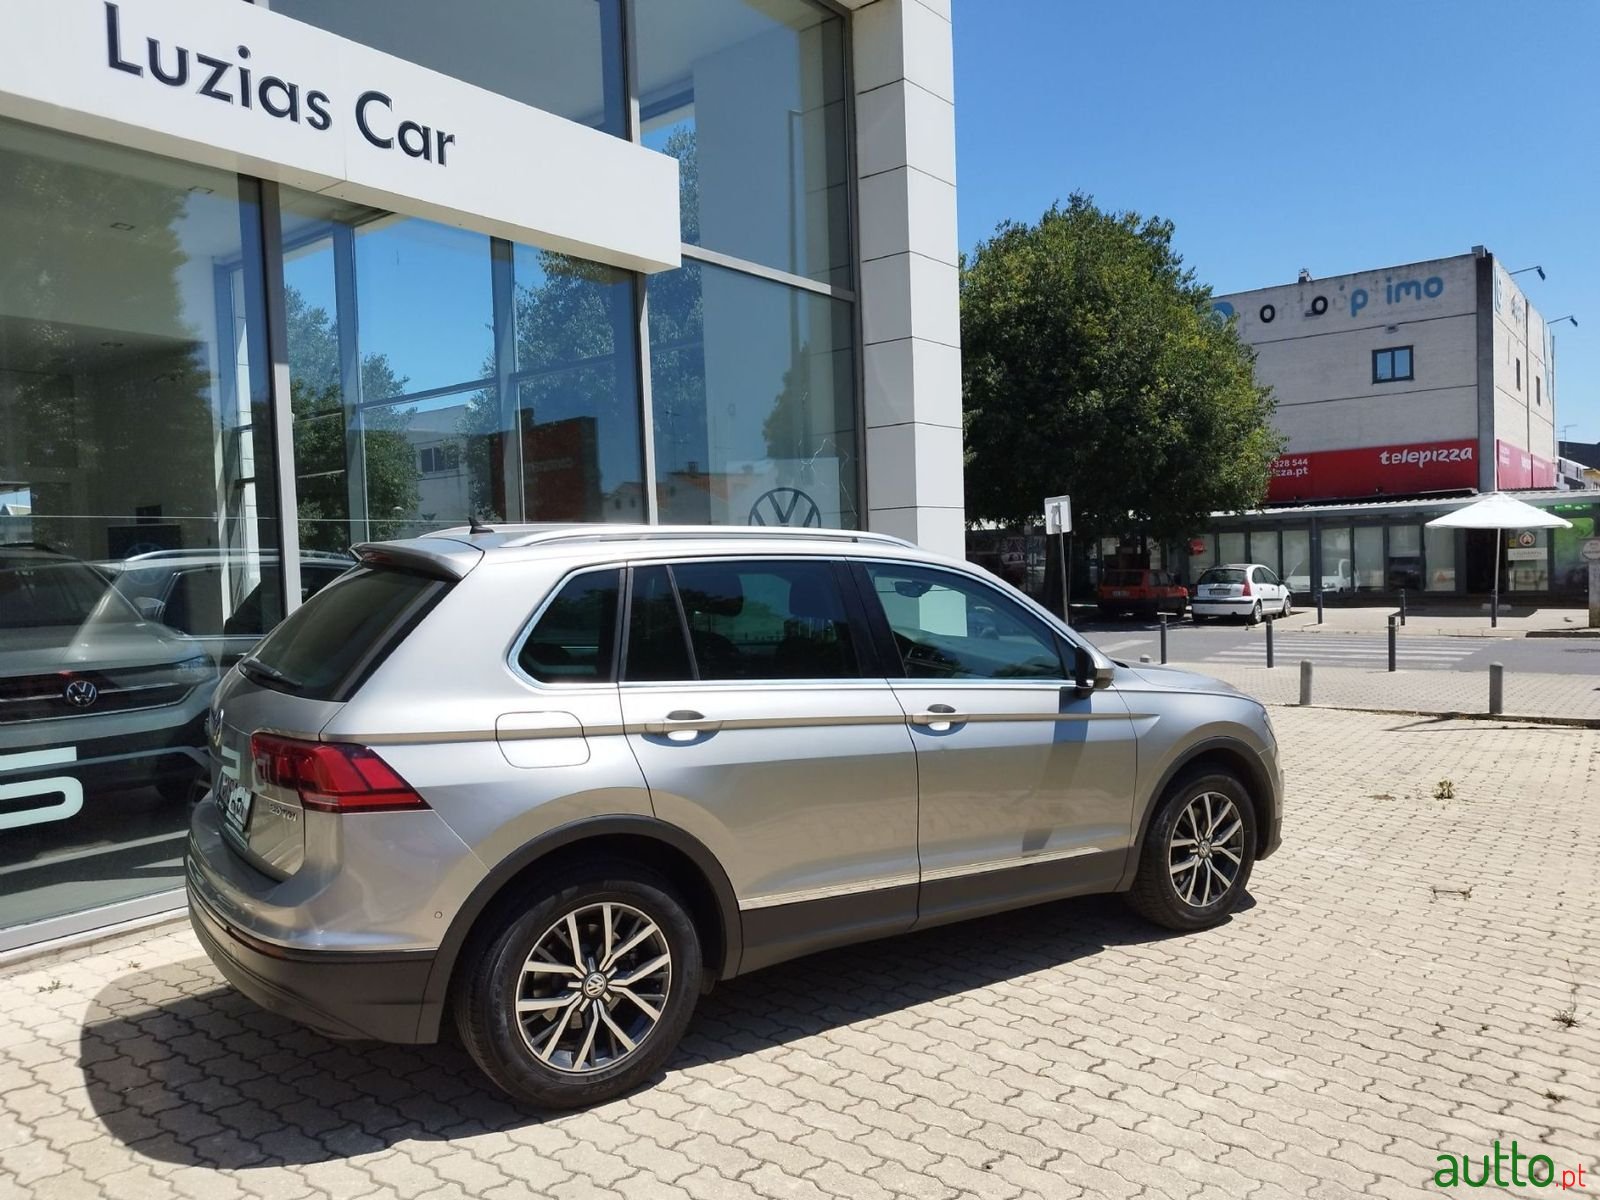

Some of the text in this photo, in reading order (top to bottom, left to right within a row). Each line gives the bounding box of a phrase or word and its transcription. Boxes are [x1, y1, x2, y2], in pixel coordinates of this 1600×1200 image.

[106, 1, 455, 167] Luzias Car
[1292, 458, 1308, 467] 544
[1379, 447, 1473, 468] telepizza
